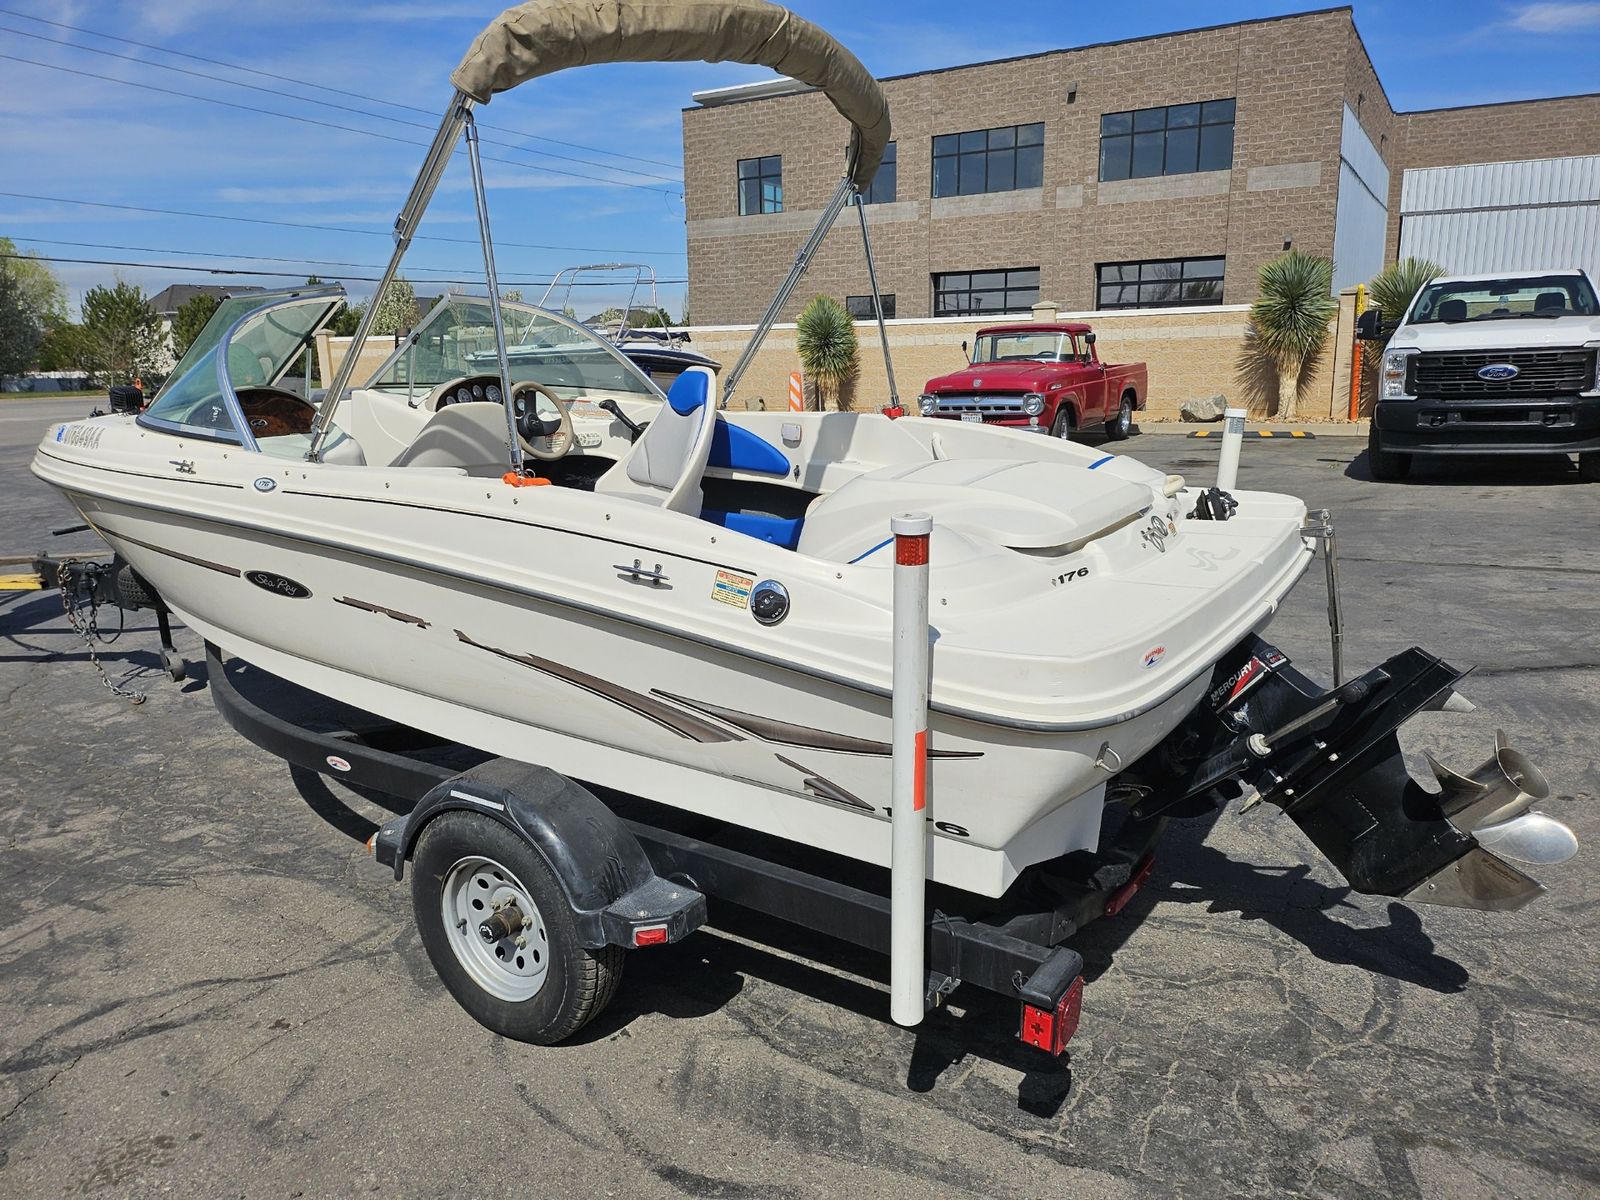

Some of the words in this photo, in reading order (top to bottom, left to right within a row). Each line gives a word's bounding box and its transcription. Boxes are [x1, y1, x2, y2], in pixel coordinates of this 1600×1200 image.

[1486, 368, 1509, 377] Ford
[254, 574, 275, 587] Sea
[276, 578, 298, 596] Ray
[1057, 567, 1089, 584] 176
[1210, 660, 1253, 702] MERCURY
